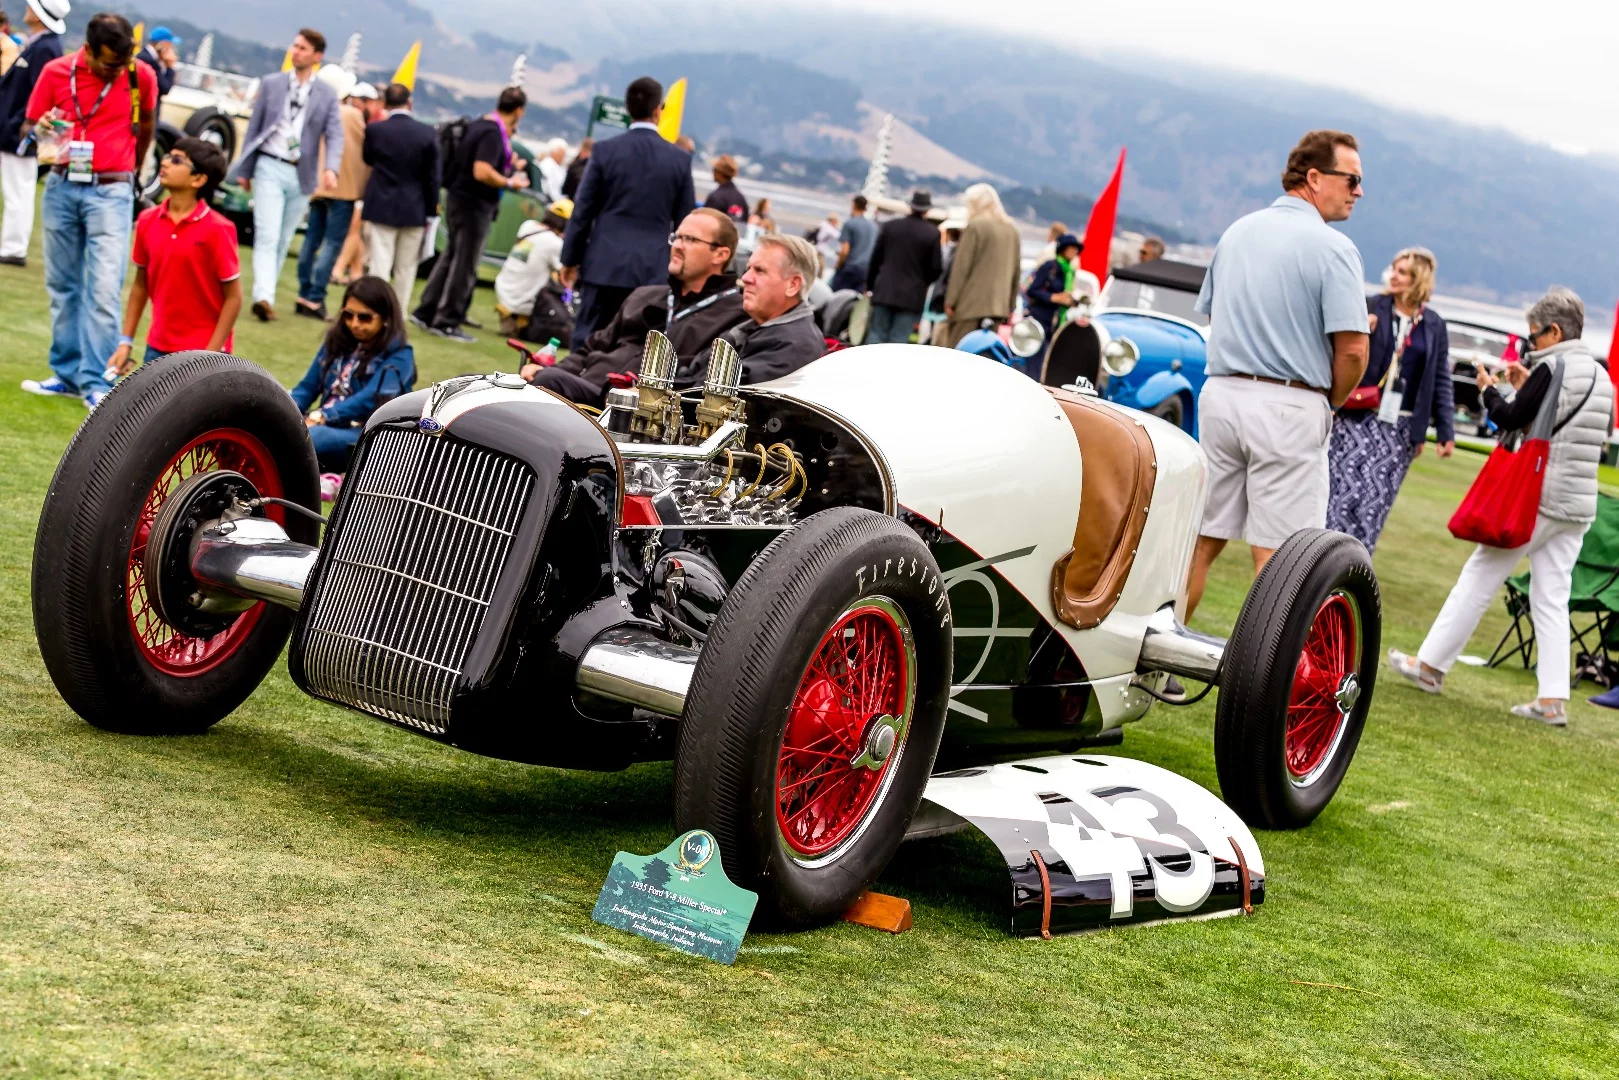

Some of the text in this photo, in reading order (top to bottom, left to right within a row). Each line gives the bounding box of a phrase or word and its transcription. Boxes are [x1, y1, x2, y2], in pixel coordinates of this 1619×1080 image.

[856, 556, 951, 628] Firestone
[1034, 785, 1216, 919] 43
[631, 880, 648, 892] 1935
[648, 885, 664, 897] Ford
[665, 890, 677, 900] V-8
[677, 894, 699, 908] Miller
[612, 903, 722, 946] Indianapolis Motor Speedway Museum
[670, 933, 695, 947] Indiana
